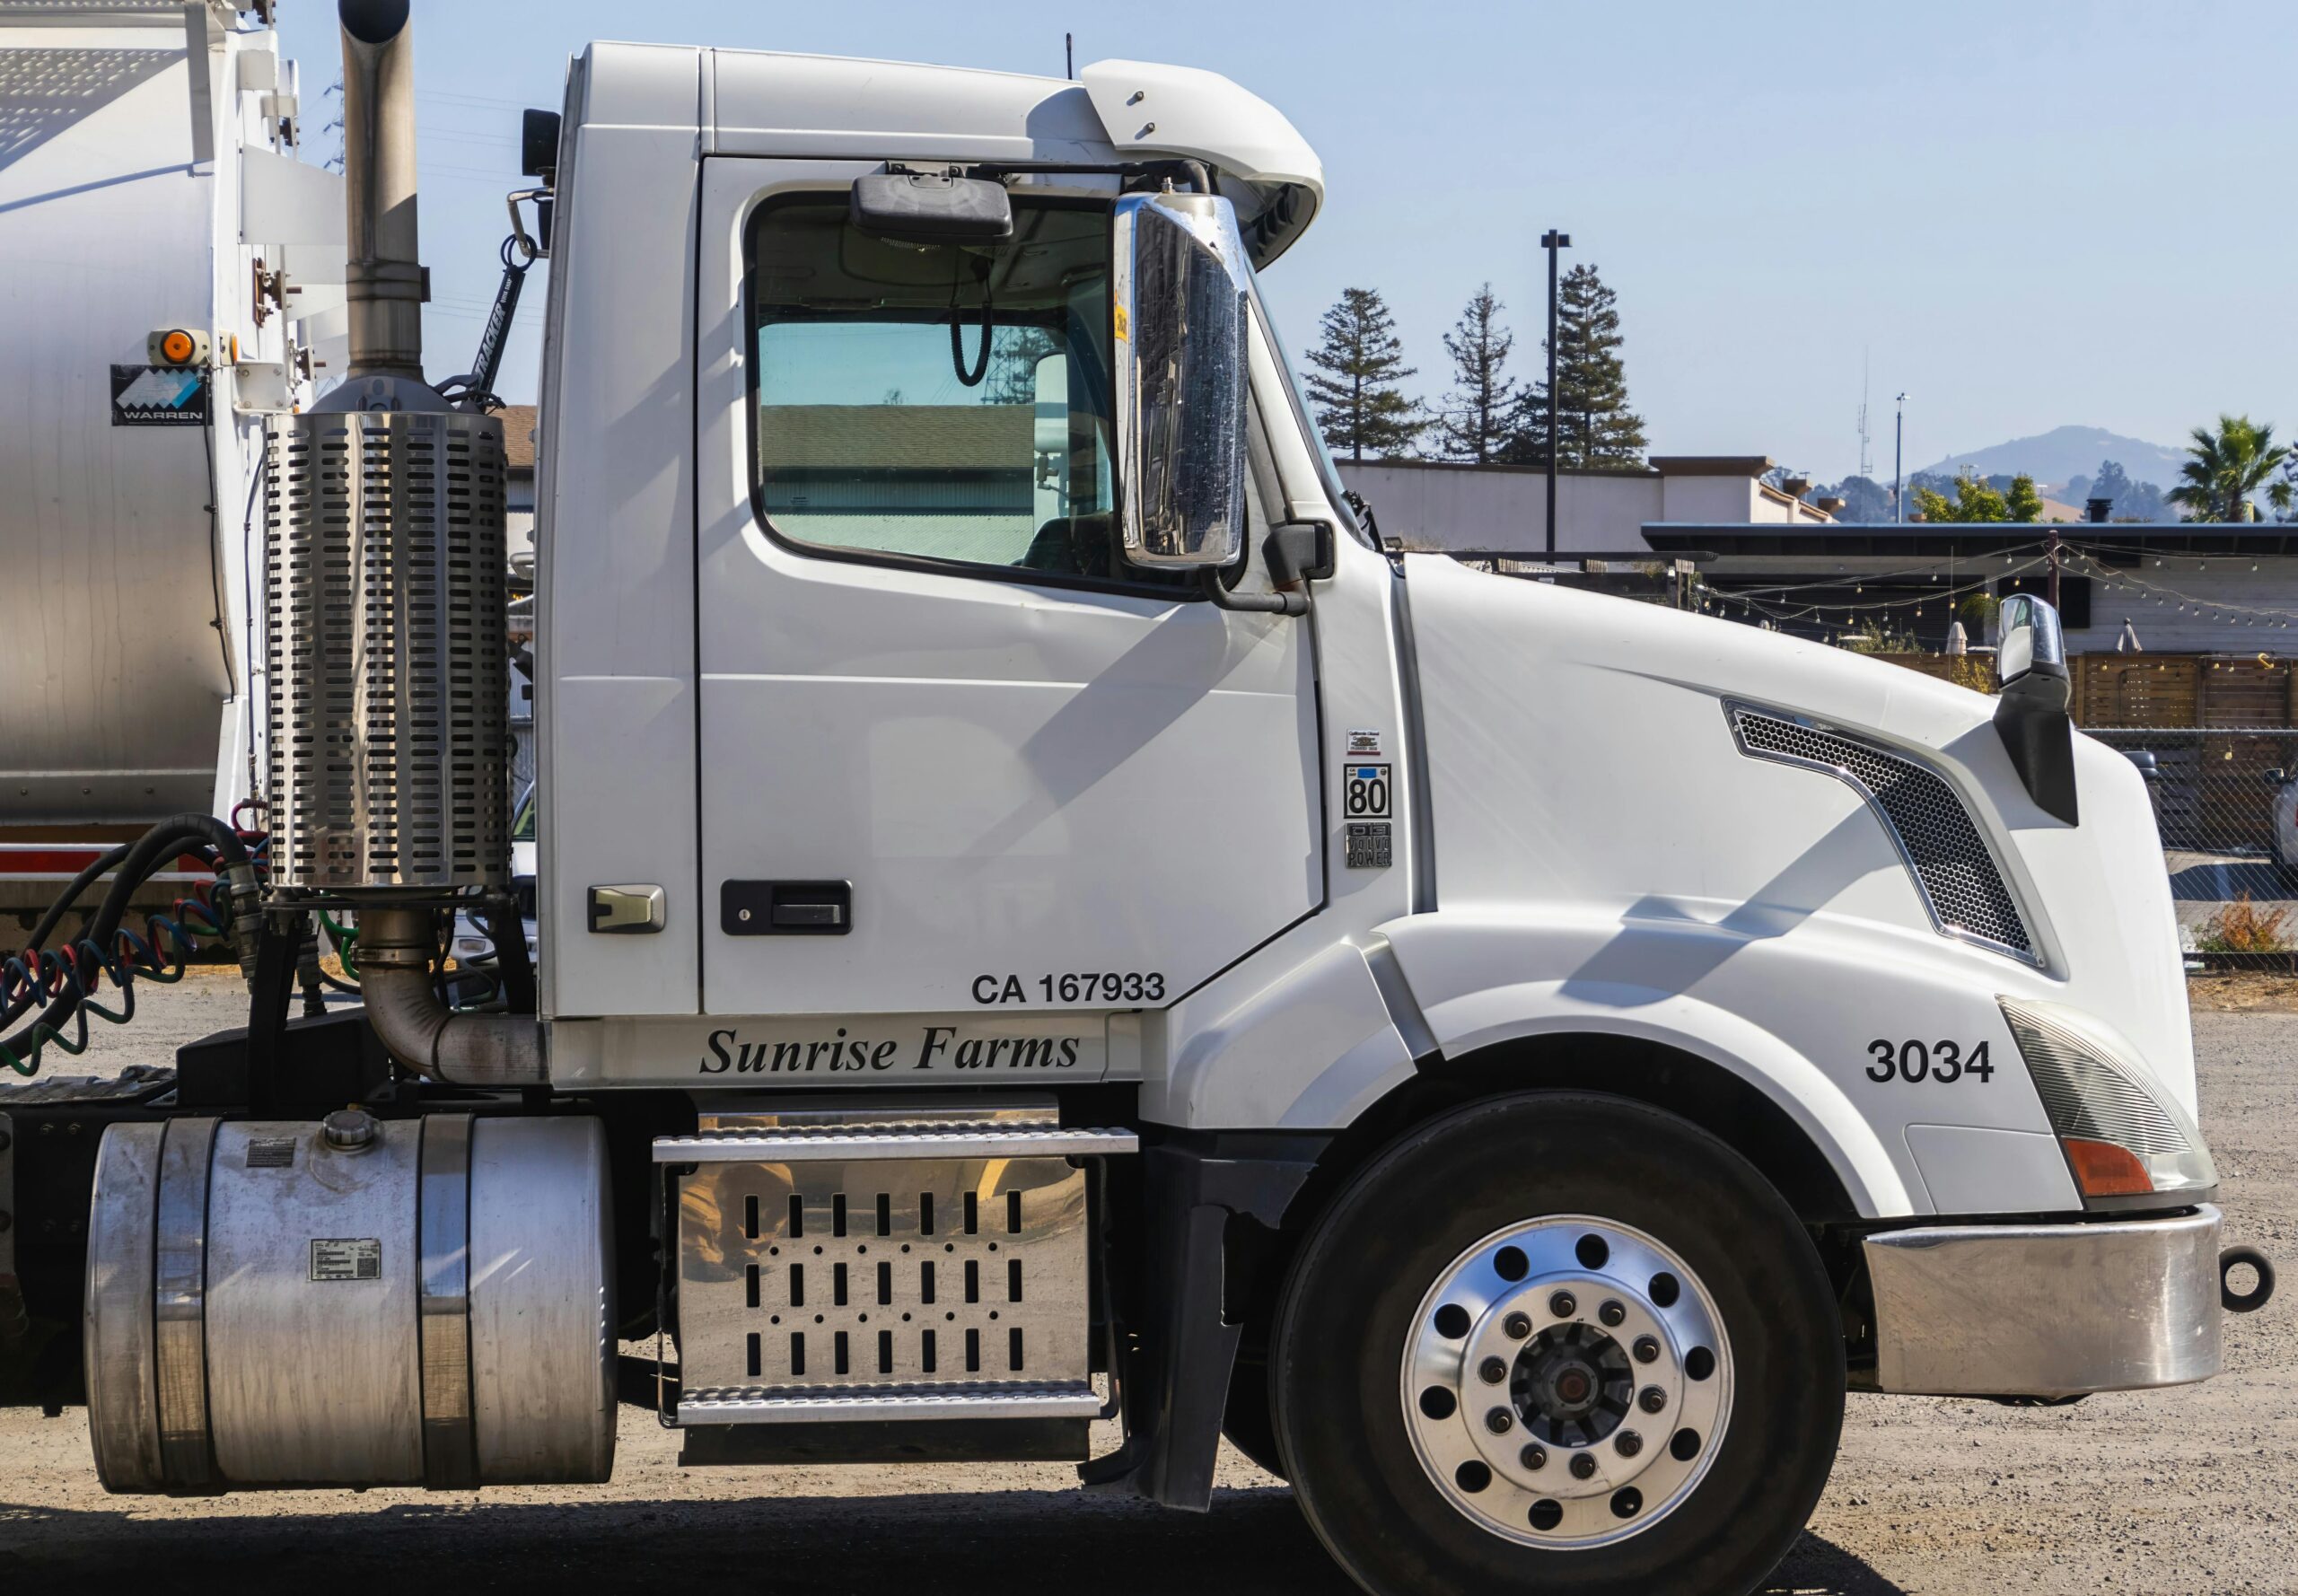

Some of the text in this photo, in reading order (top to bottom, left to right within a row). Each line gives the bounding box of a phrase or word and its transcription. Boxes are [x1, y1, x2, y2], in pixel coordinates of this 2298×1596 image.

[474, 302, 507, 388] TRACKER
[1348, 779, 1386, 814] 80
[1349, 837, 1390, 851] VOLVO
[1349, 852, 1390, 866] POWER
[971, 972, 1165, 1004] CA 167933
[699, 1026, 1081, 1074] Sunrise Farms
[1865, 1039, 1995, 1083] 3034
